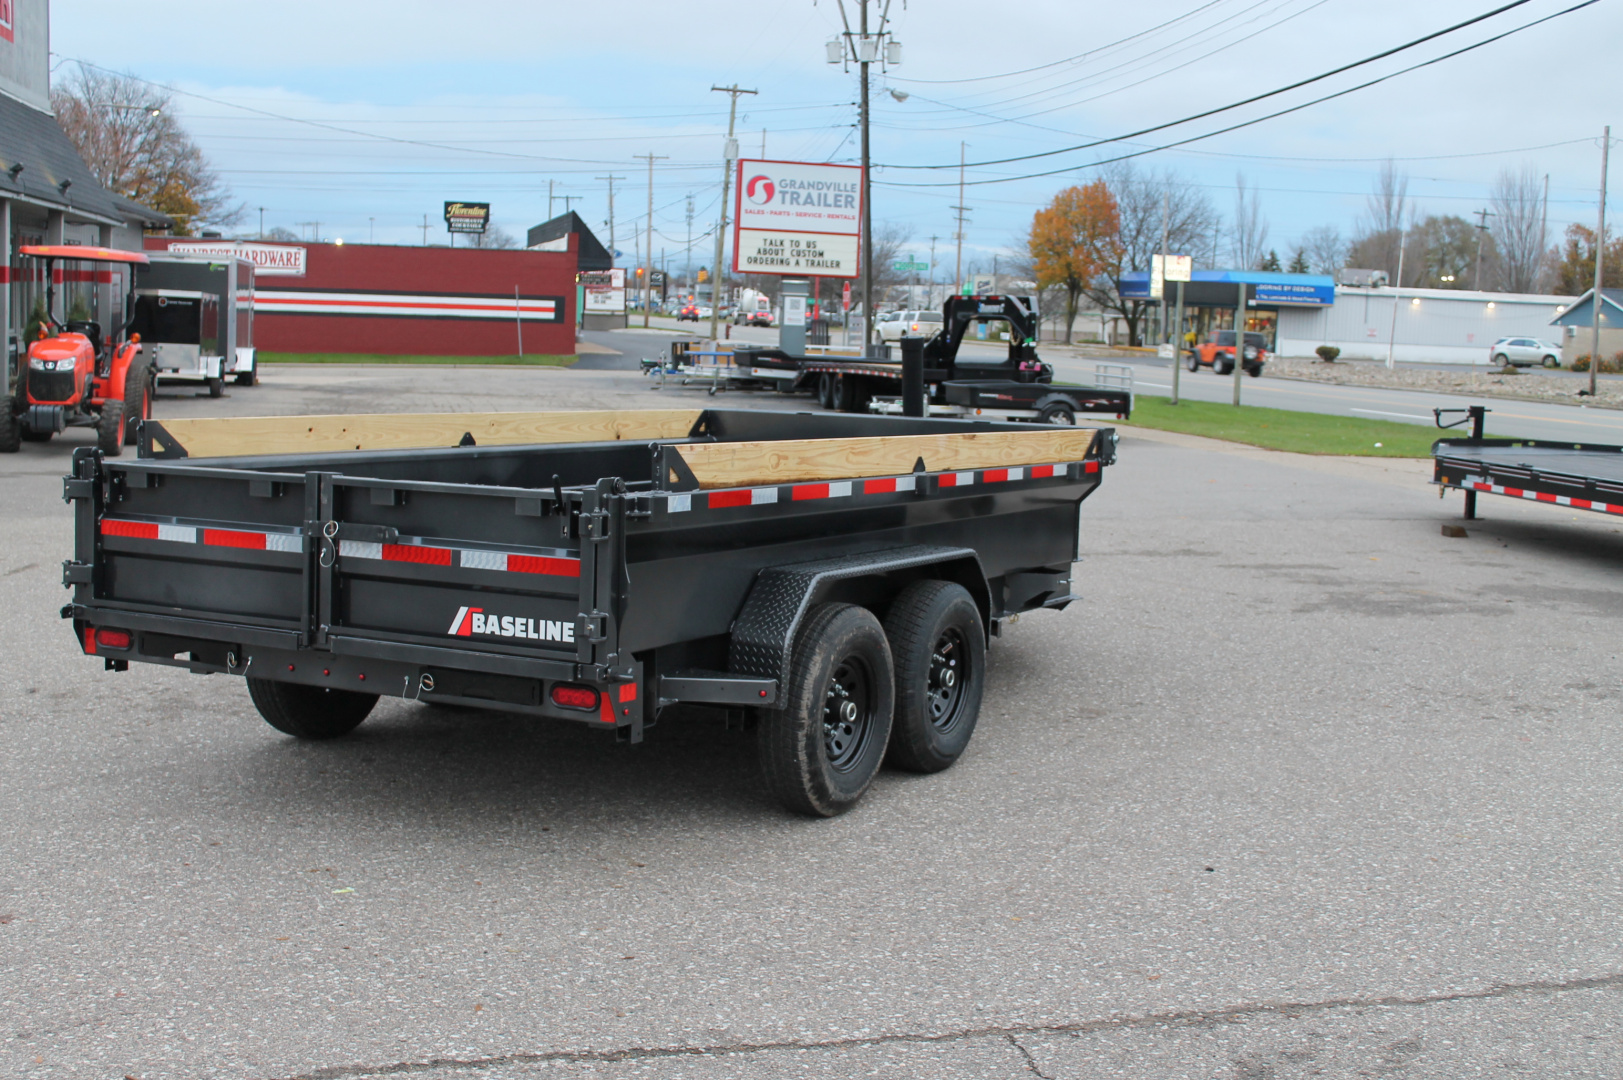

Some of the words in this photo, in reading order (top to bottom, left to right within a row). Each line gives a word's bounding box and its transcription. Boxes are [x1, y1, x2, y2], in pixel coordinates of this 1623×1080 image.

[779, 179, 857, 193] GRANDVILLE
[779, 190, 855, 209] TRAILER
[446, 203, 487, 217] Florentine
[763, 238, 785, 247] TALK
[790, 240, 800, 248] TO
[806, 240, 817, 249] US
[757, 248, 785, 256] ABOUT
[790, 249, 824, 258] CUSTOM
[747, 256, 790, 266] ORDERING
[795, 259, 800, 267] A
[805, 259, 841, 268] TRAILER
[472, 612, 575, 643] BASELINE
